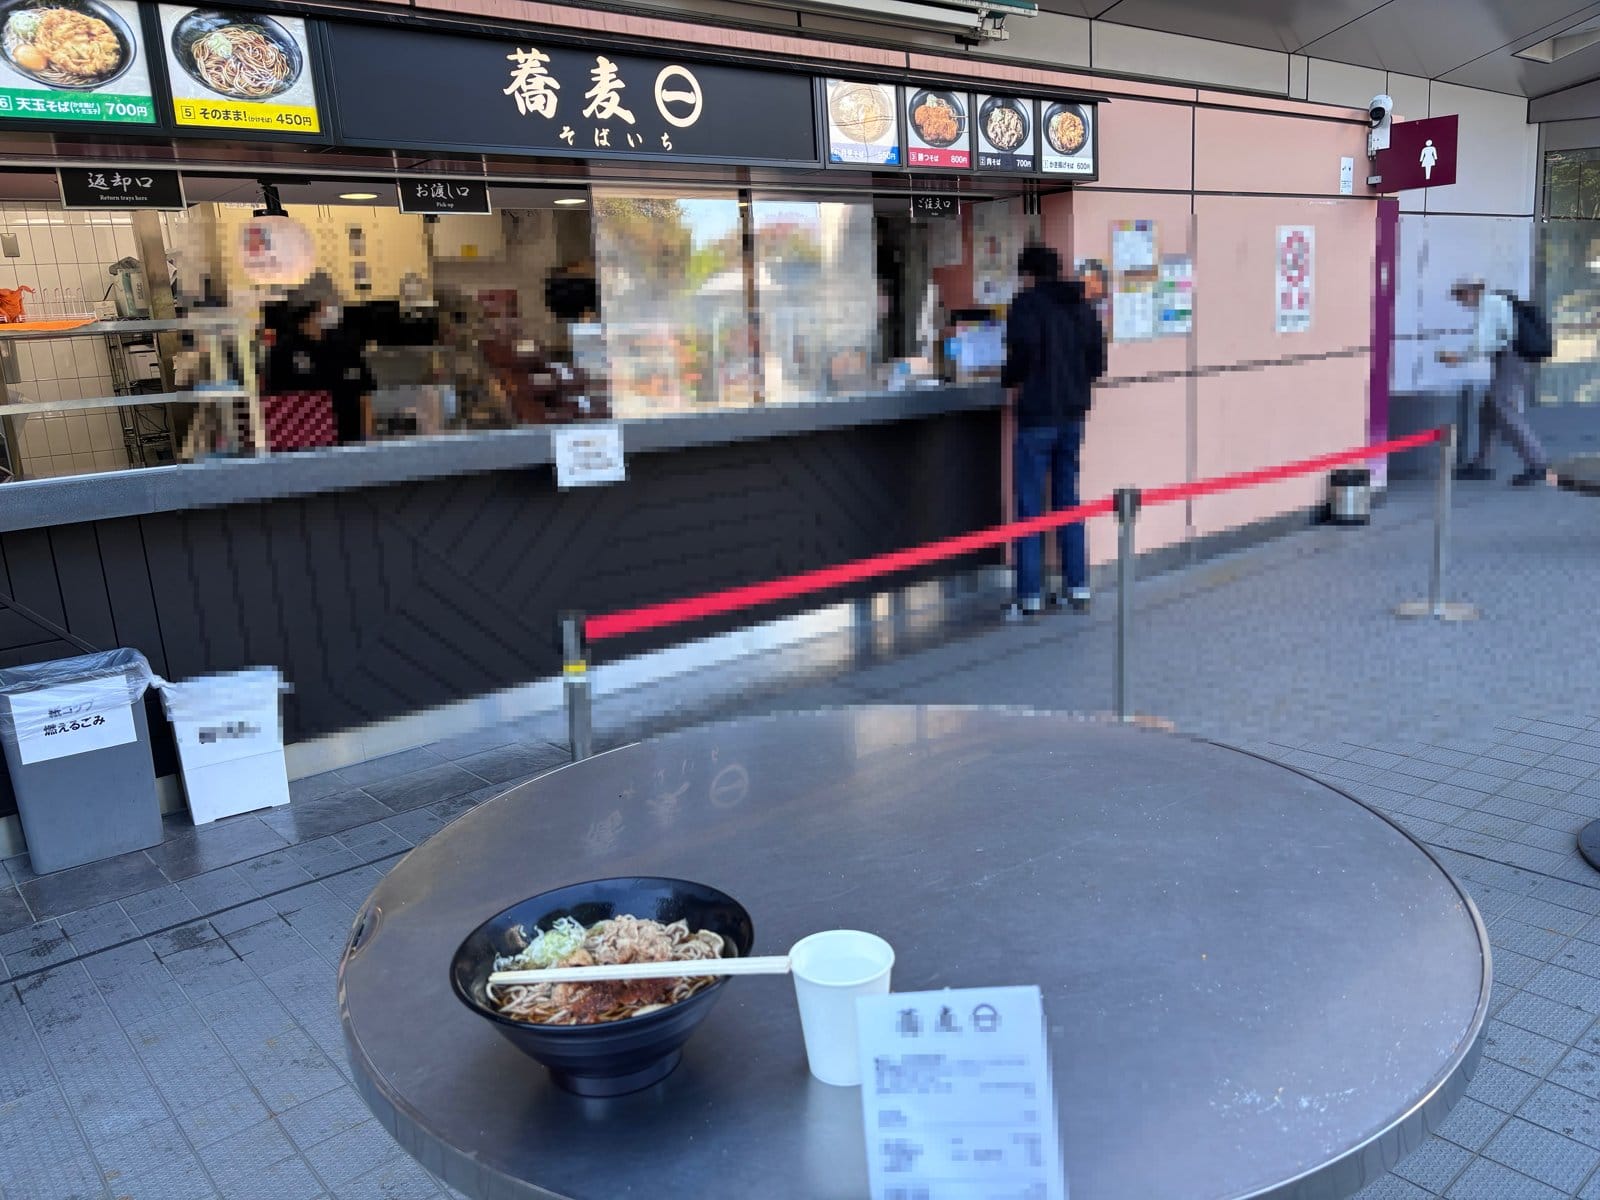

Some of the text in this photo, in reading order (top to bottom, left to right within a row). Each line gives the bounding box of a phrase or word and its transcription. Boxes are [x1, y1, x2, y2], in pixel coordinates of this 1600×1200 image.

[15, 97, 70, 113] 天玉そば
[104, 102, 148, 117] 700円
[275, 113, 312, 126] 450円
[559, 125, 673, 151] そばいち
[1016, 159, 1032, 168] 700円
[1076, 161, 1091, 170] 600円
[87, 172, 154, 192] 返却口
[416, 183, 470, 199] お渡し口
[918, 197, 951, 210] ご注文口
